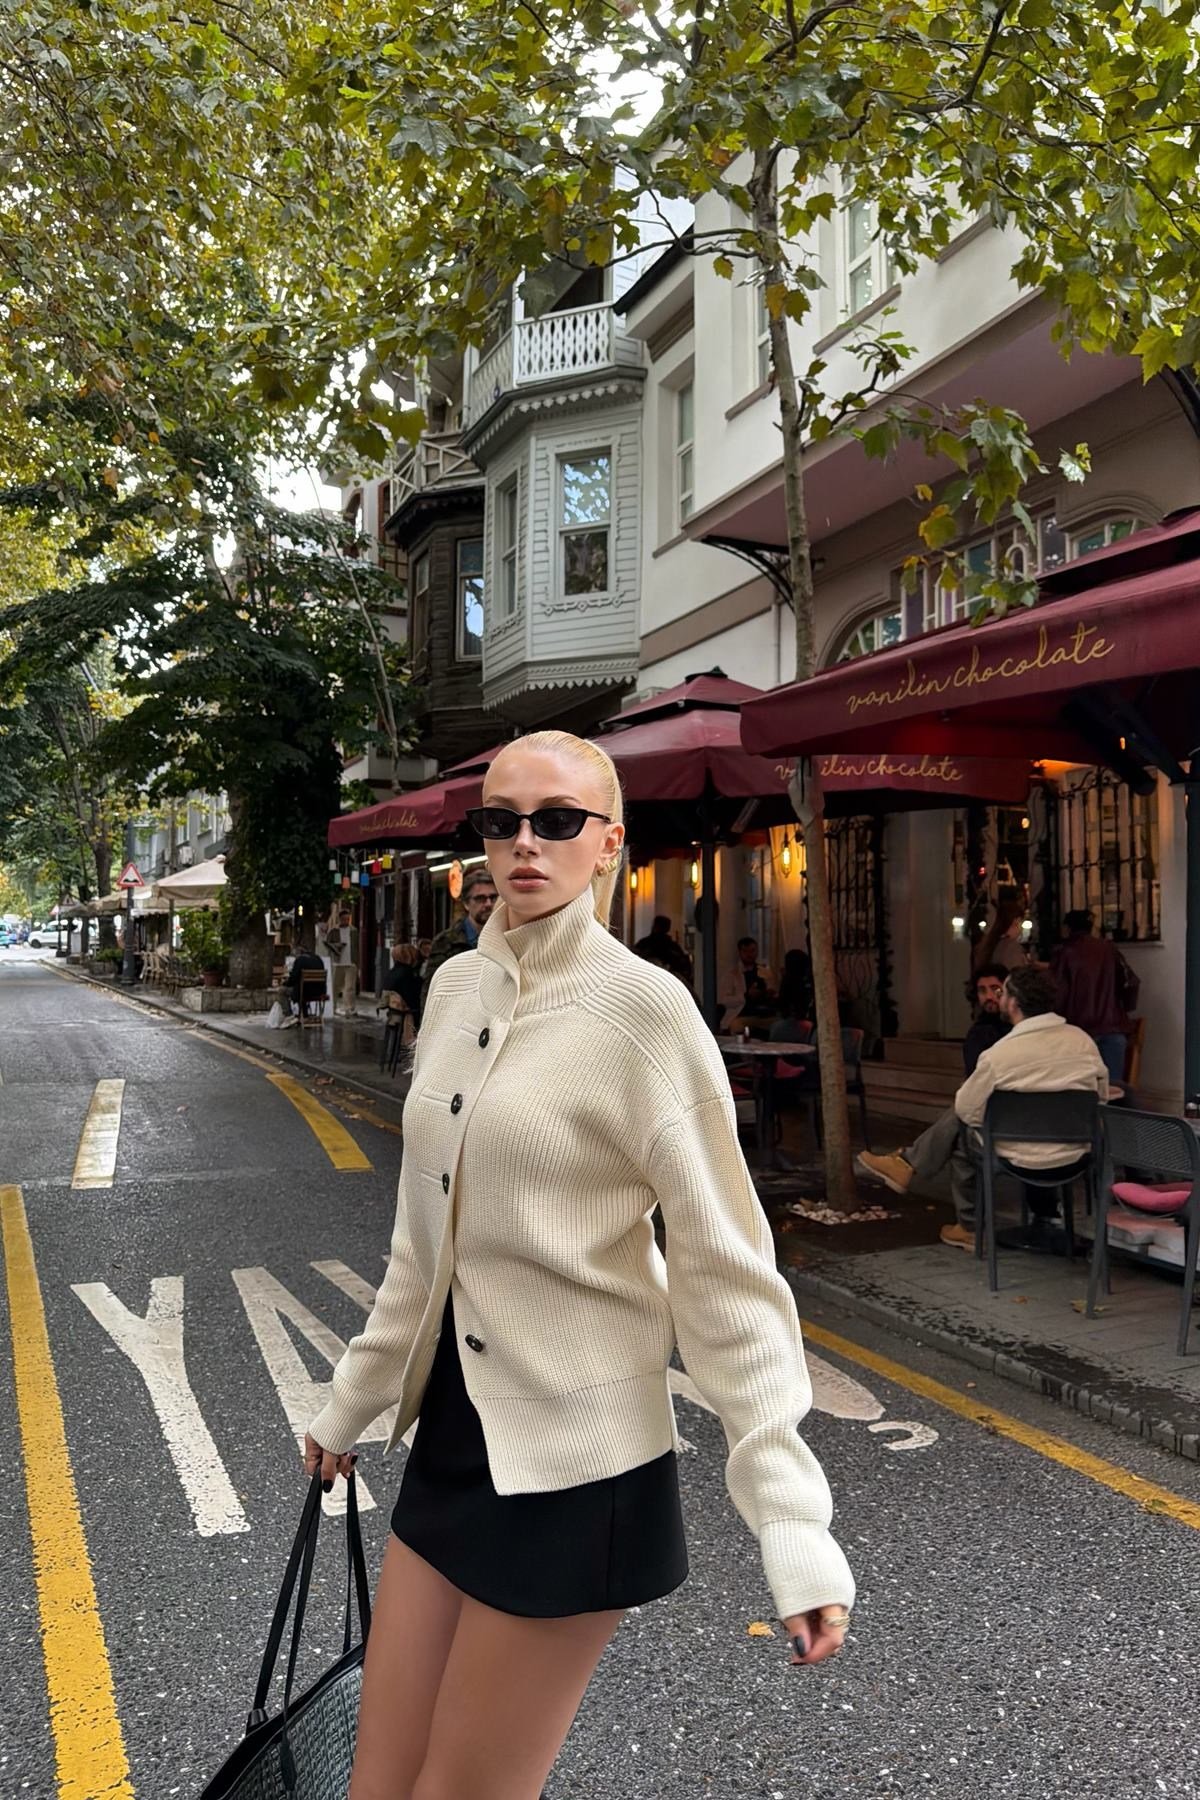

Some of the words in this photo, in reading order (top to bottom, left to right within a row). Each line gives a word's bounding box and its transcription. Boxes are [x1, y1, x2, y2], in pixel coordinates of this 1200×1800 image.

[847, 659, 951, 714] vanilin
[953, 622, 1115, 687] chocolate
[867, 755, 964, 781] chocolate
